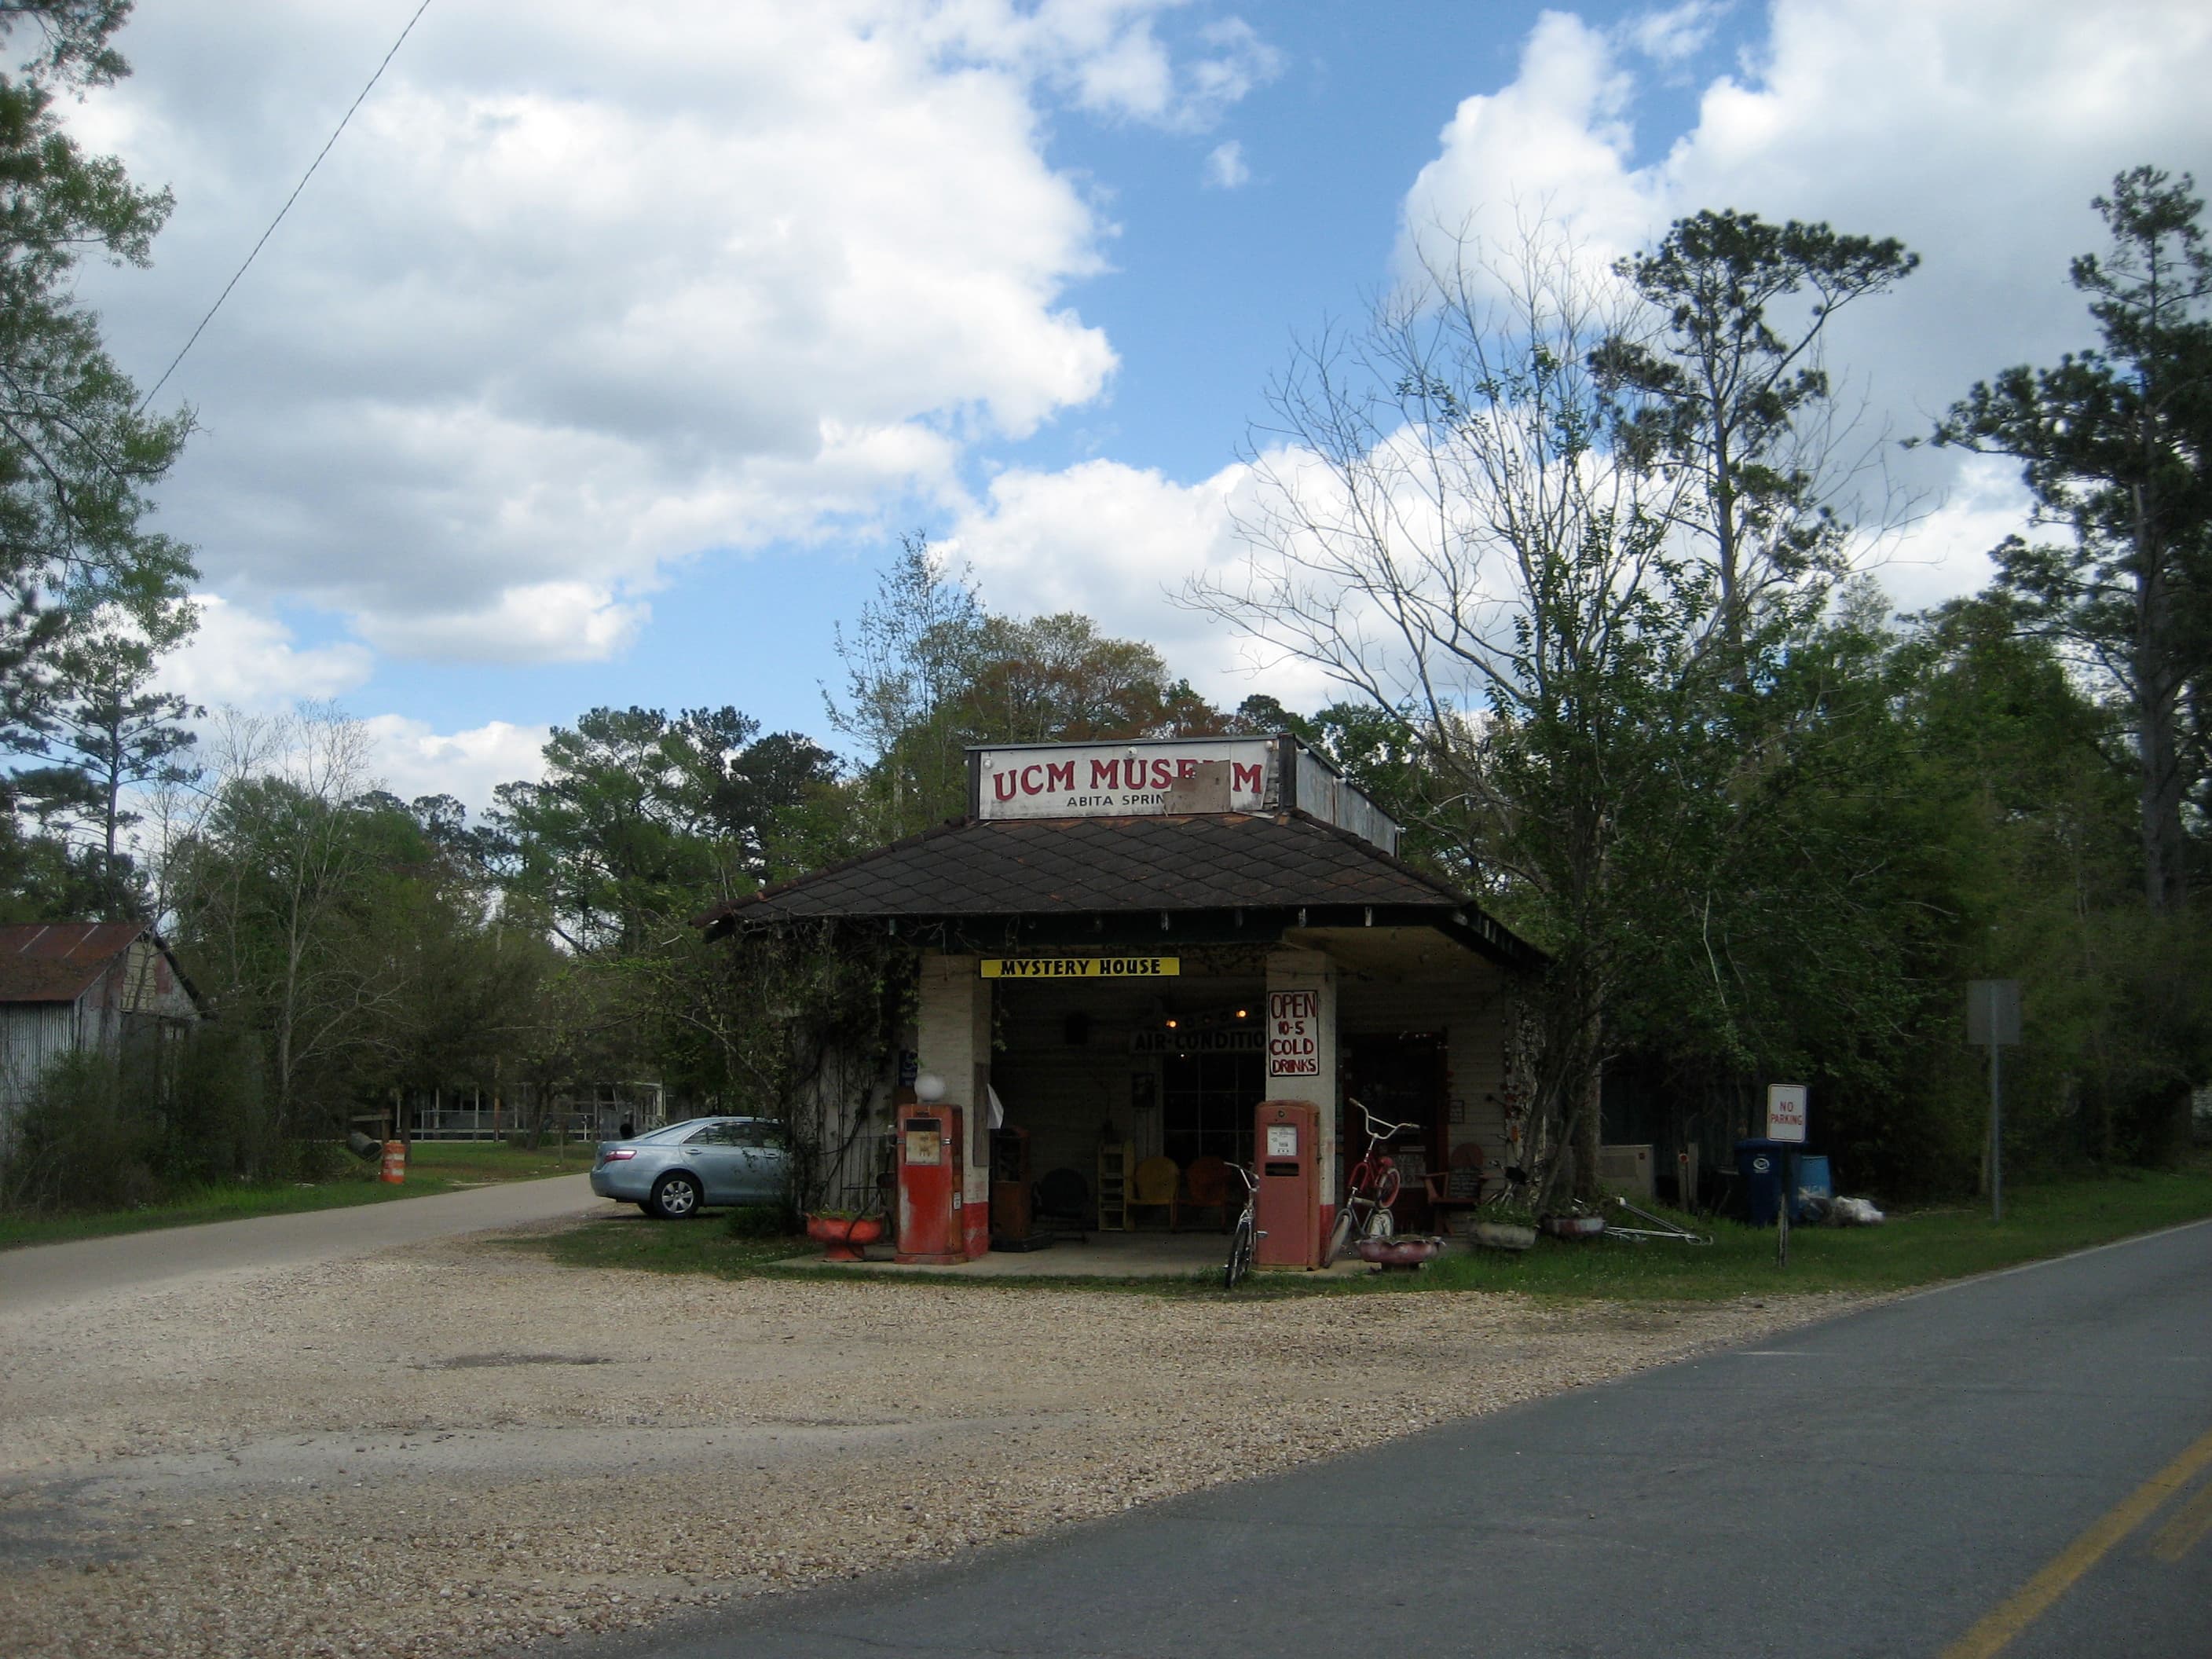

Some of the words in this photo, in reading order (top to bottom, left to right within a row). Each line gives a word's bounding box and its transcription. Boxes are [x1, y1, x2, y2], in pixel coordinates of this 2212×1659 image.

[993, 760, 1076, 800] UCM
[1090, 758, 1263, 793] MUSEM
[1067, 796, 1114, 807] ABITA
[1001, 960, 1090, 975] MYSTERY
[1100, 958, 1161, 975] HOUSE
[1271, 994, 1317, 1019] OPEN
[1278, 1021, 1305, 1035] 10-5
[1269, 1038, 1314, 1056] COLD
[1273, 1059, 1317, 1073] DRINKS
[1779, 1101, 1794, 1112] NO
[1771, 1114, 1803, 1125] PARKING
